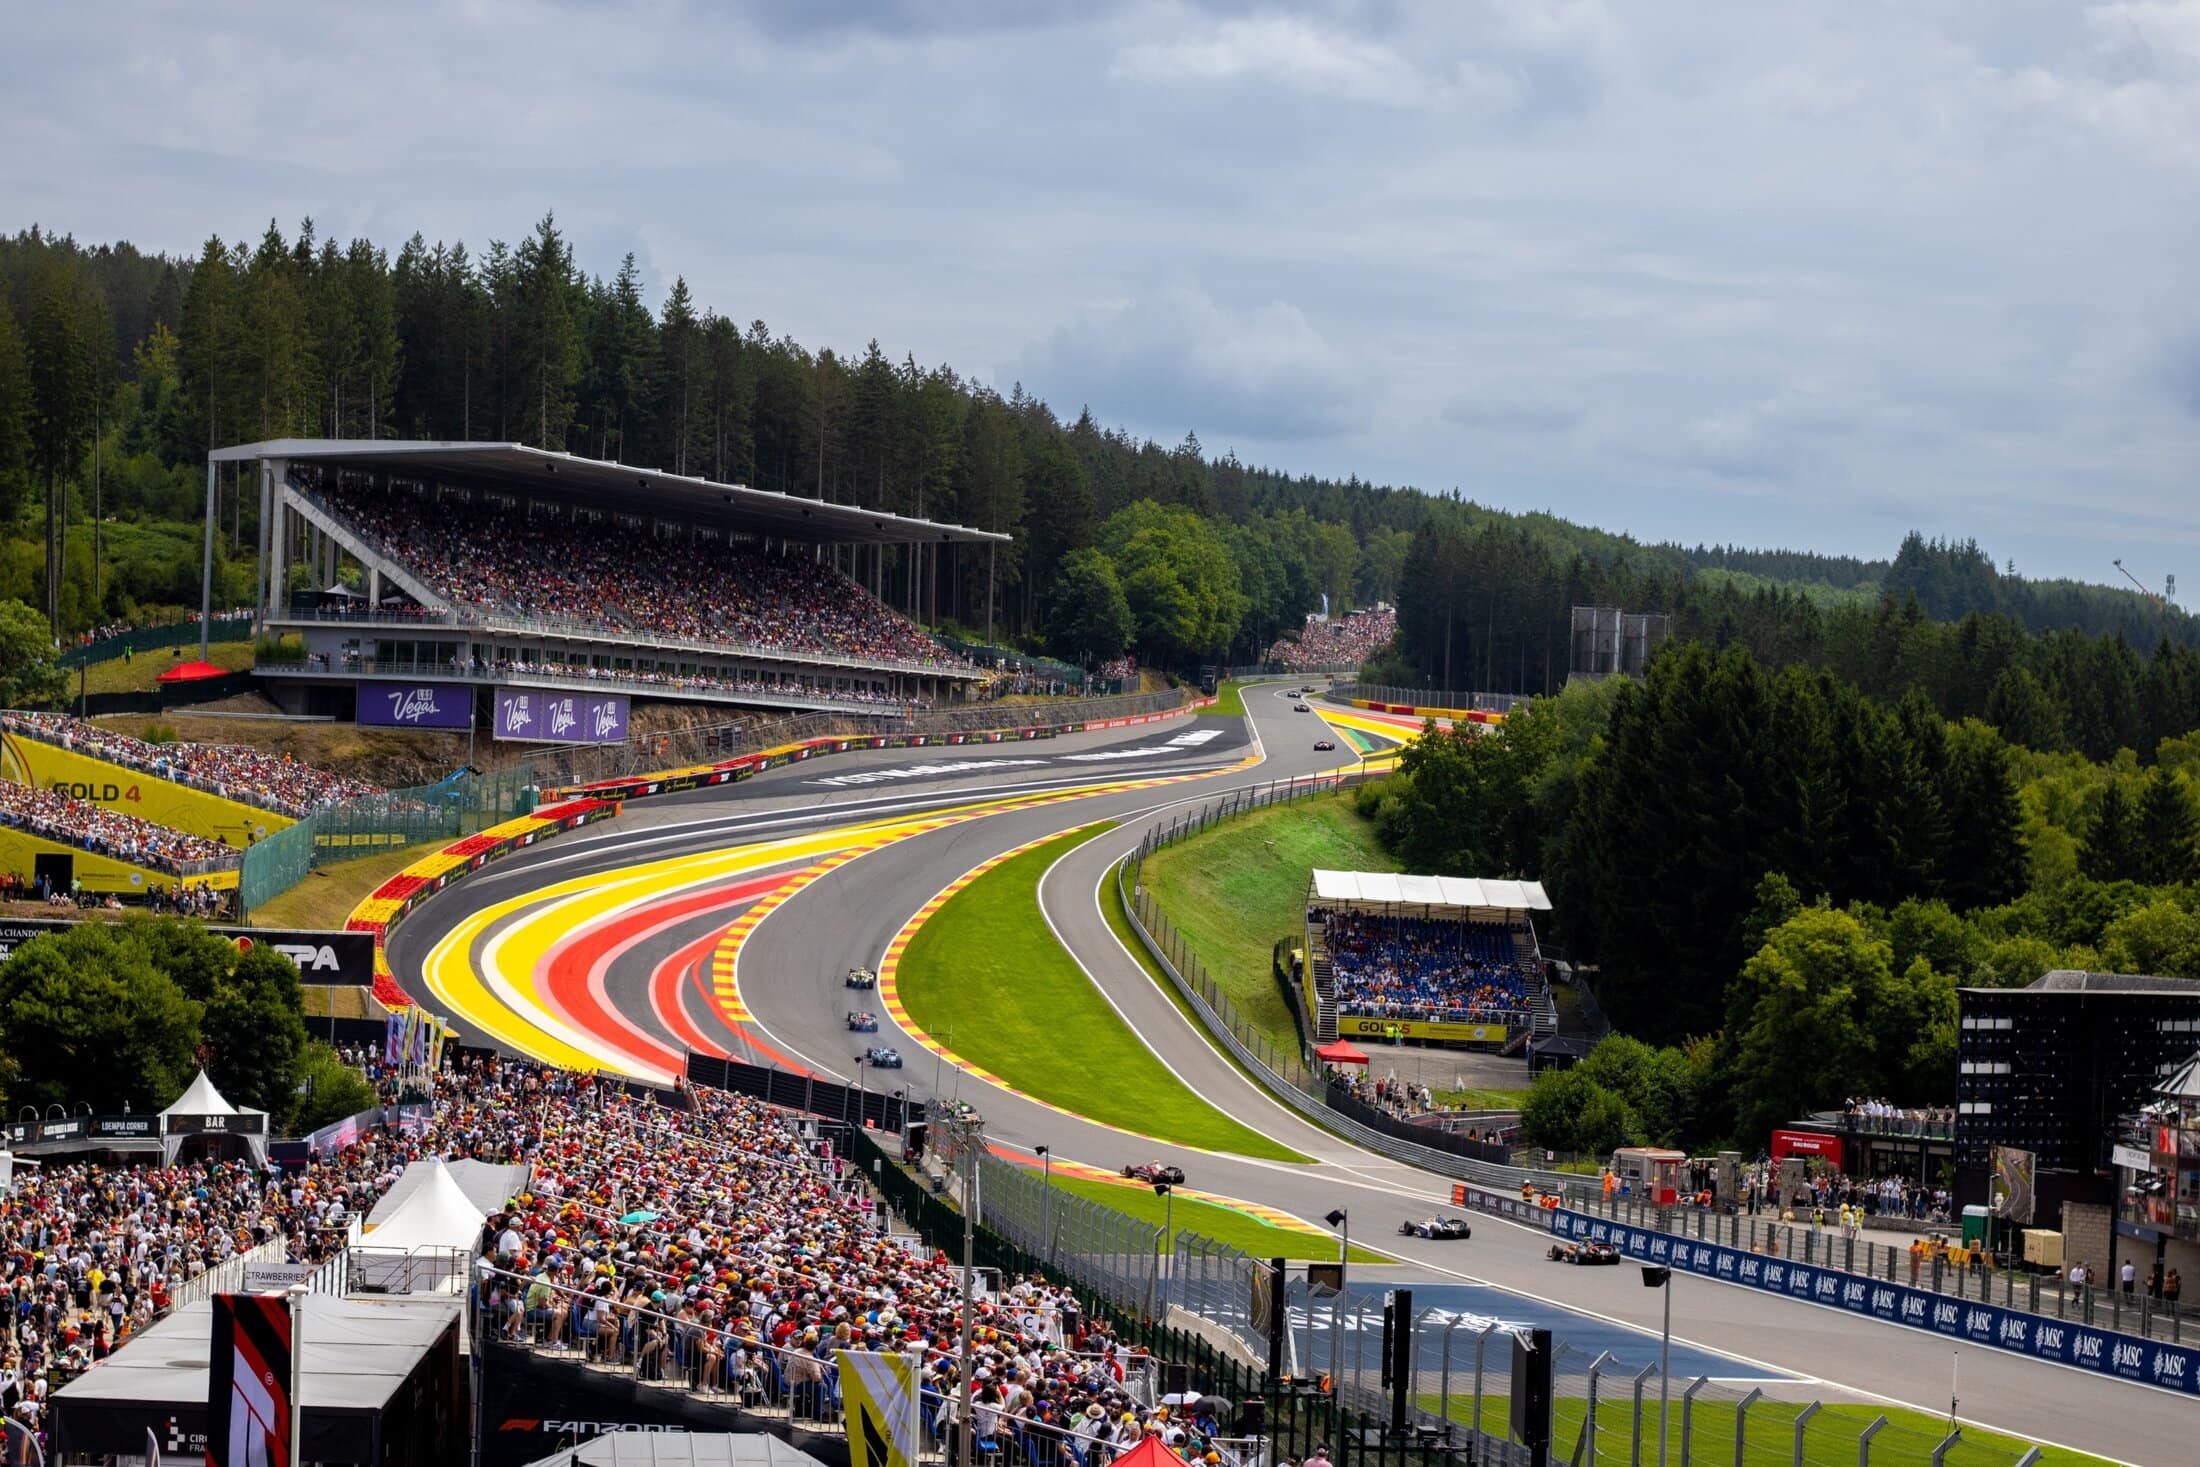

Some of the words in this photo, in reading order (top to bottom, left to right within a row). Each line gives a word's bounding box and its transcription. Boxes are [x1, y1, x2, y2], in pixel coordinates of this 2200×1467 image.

[388, 690, 440, 722] Vegas
[504, 698, 532, 734] Vegas
[549, 702, 576, 736] Vegas
[593, 705, 618, 738] Vegas
[125, 785, 142, 803] 4
[4, 928, 44, 937] CHANDO
[205, 1117, 225, 1128] BAR
[1614, 1229, 1625, 1244] MSC
[1635, 1234, 1646, 1250] MSC
[1655, 1239, 1667, 1254] MSC
[1677, 1244, 1689, 1260] MSC
[1699, 1249, 1712, 1265] MSC
[1721, 1254, 1734, 1271] MSC
[1744, 1260, 1759, 1277] MSC
[1770, 1264, 1784, 1282] MSC
[1795, 1270, 1810, 1288] MSC
[1822, 1276, 1838, 1294] MSC
[1849, 1283, 1866, 1301] MSC
[1878, 1289, 1896, 1308] MSC
[1908, 1297, 1926, 1316] MSC
[1940, 1304, 1958, 1324] MSC
[1024, 1316, 1034, 1328] C
[1974, 1311, 1992, 1332] MSC
[2008, 1319, 2028, 1340] MSC
[2044, 1327, 2064, 1349] MSC
[2082, 1335, 2103, 1358] MSC
[2121, 1344, 2143, 1367] MSC
[2163, 1353, 2186, 1376] MSC
[190, 1434, 207, 1442] CIR
